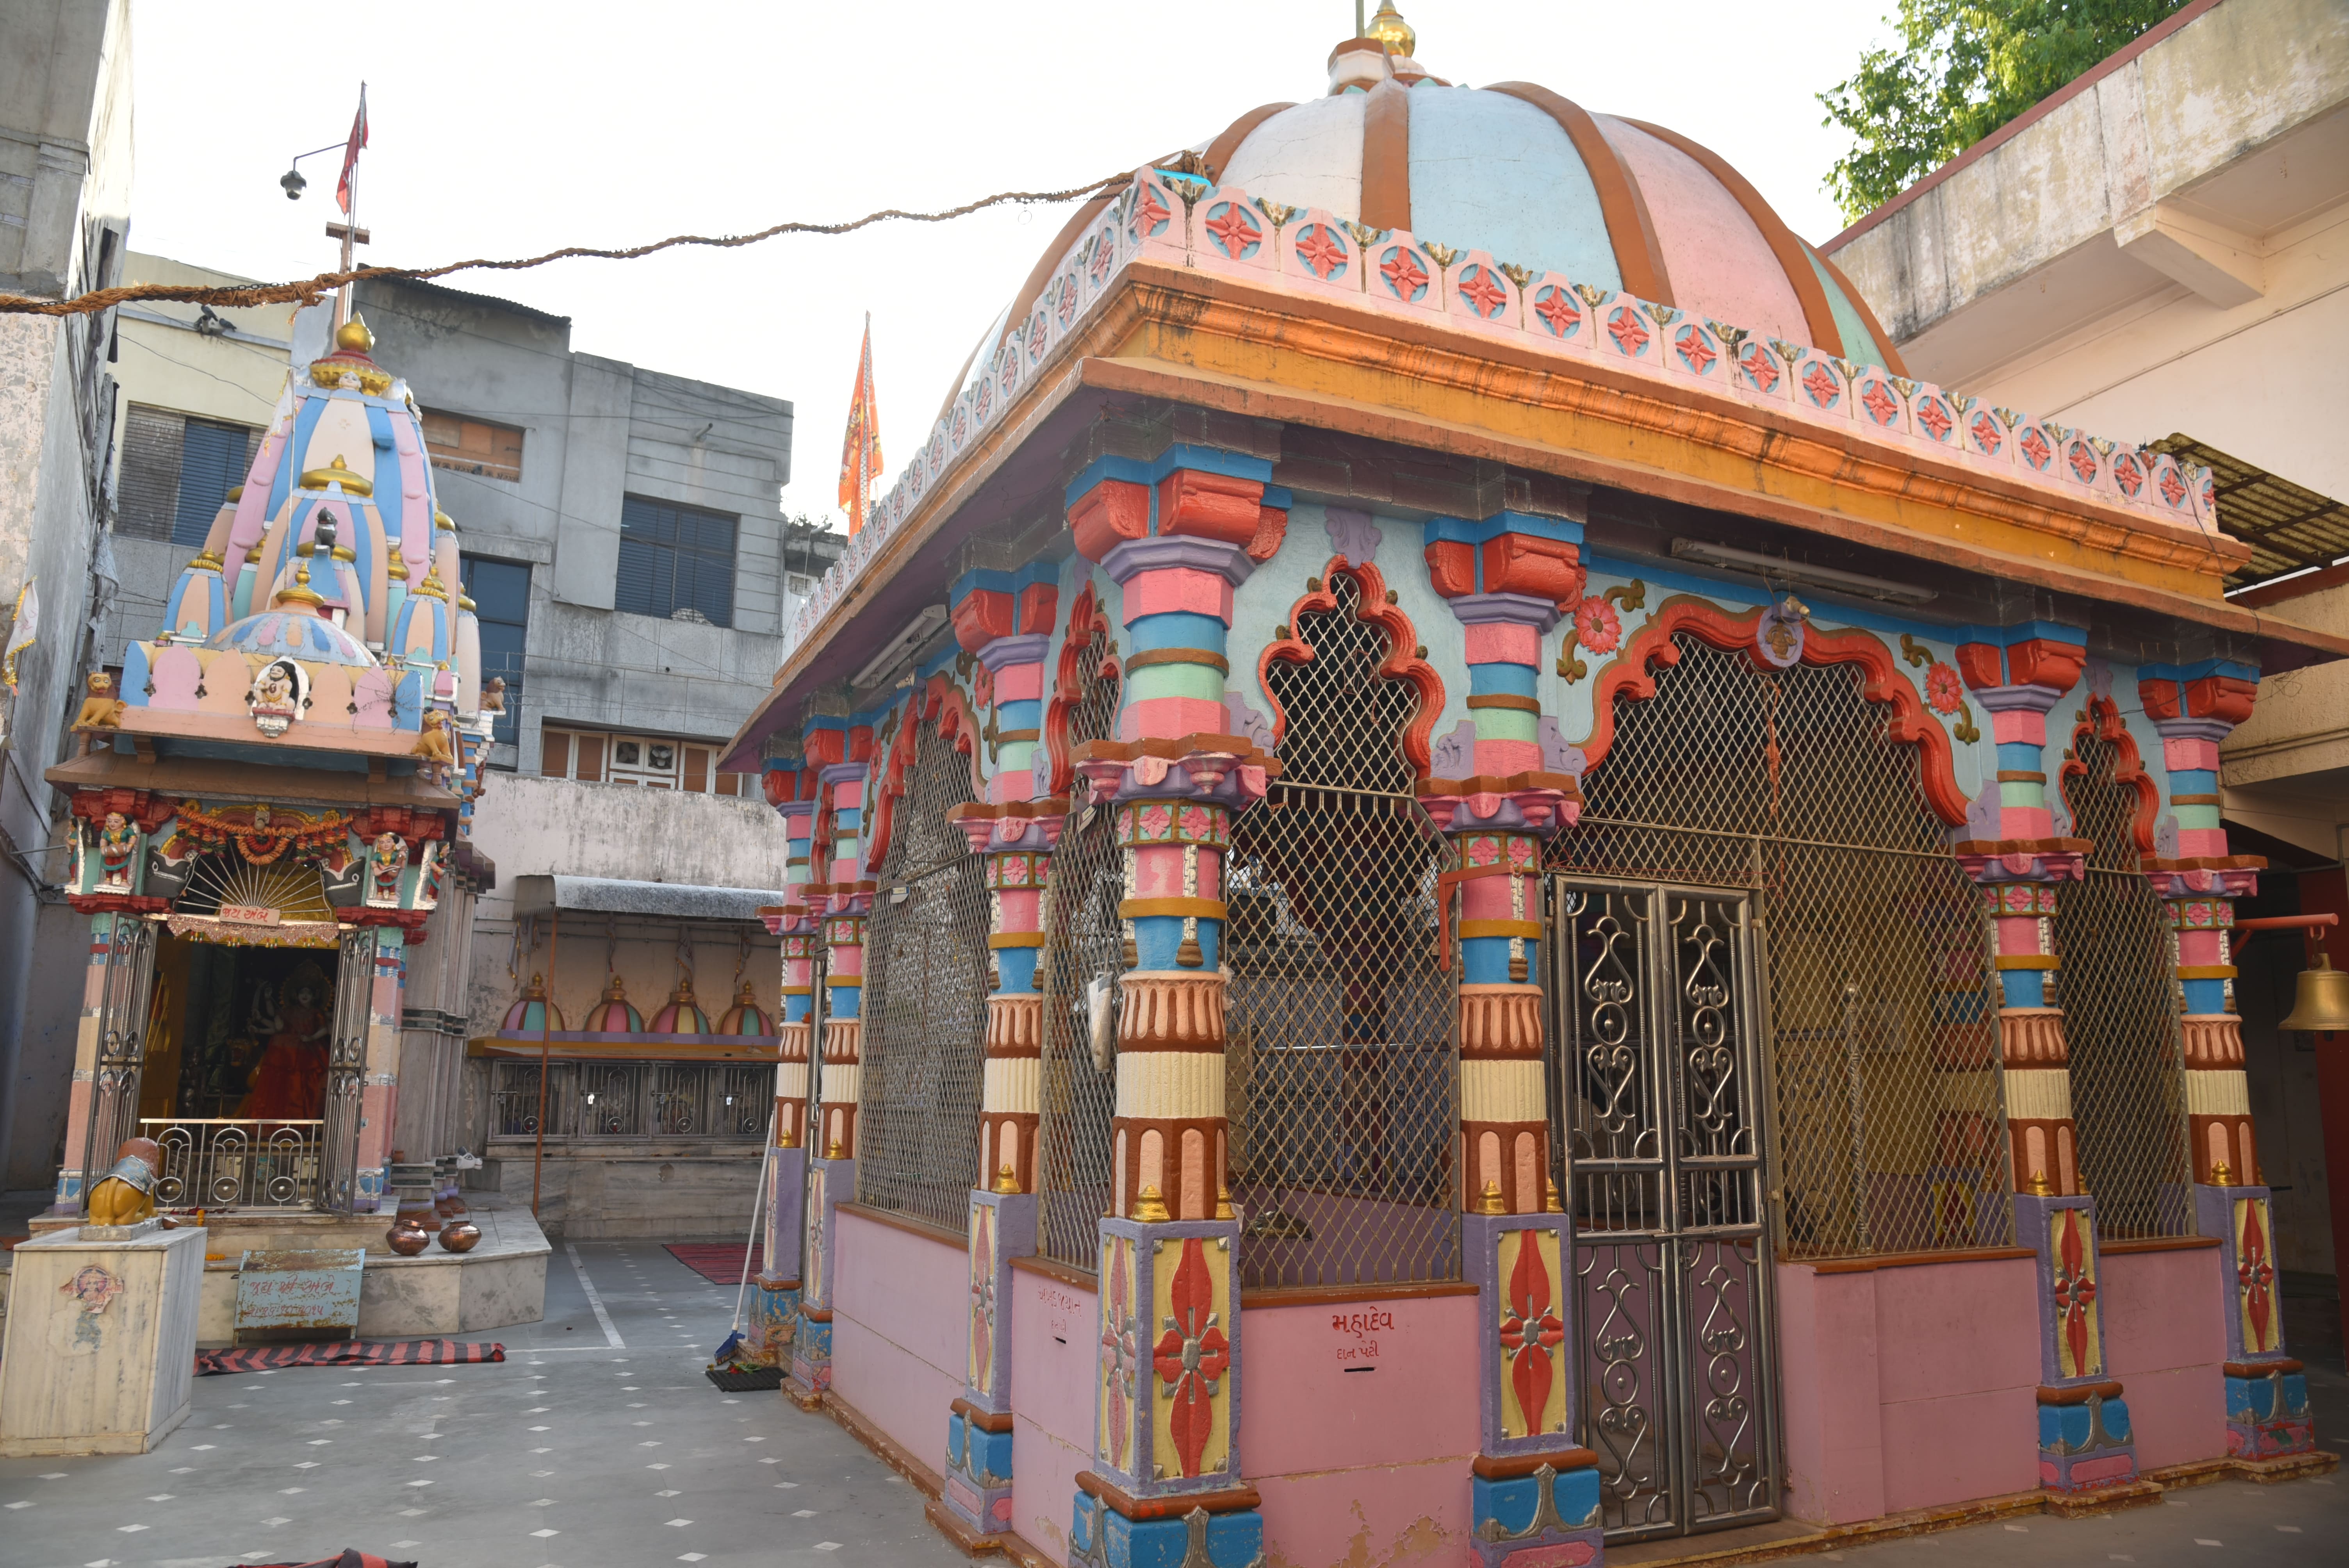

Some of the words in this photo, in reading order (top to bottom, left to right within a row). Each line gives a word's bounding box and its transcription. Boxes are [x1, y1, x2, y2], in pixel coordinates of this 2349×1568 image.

[222, 908, 241, 919] જય
[243, 908, 269, 922] અંબે
[250, 1282, 272, 1296] જય
[301, 1274, 336, 1295] અંબે
[1332, 1306, 1394, 1338] મહાદેવ
[1337, 1347, 1356, 1360] દાન
[1358, 1340, 1379, 1358] પેટી
